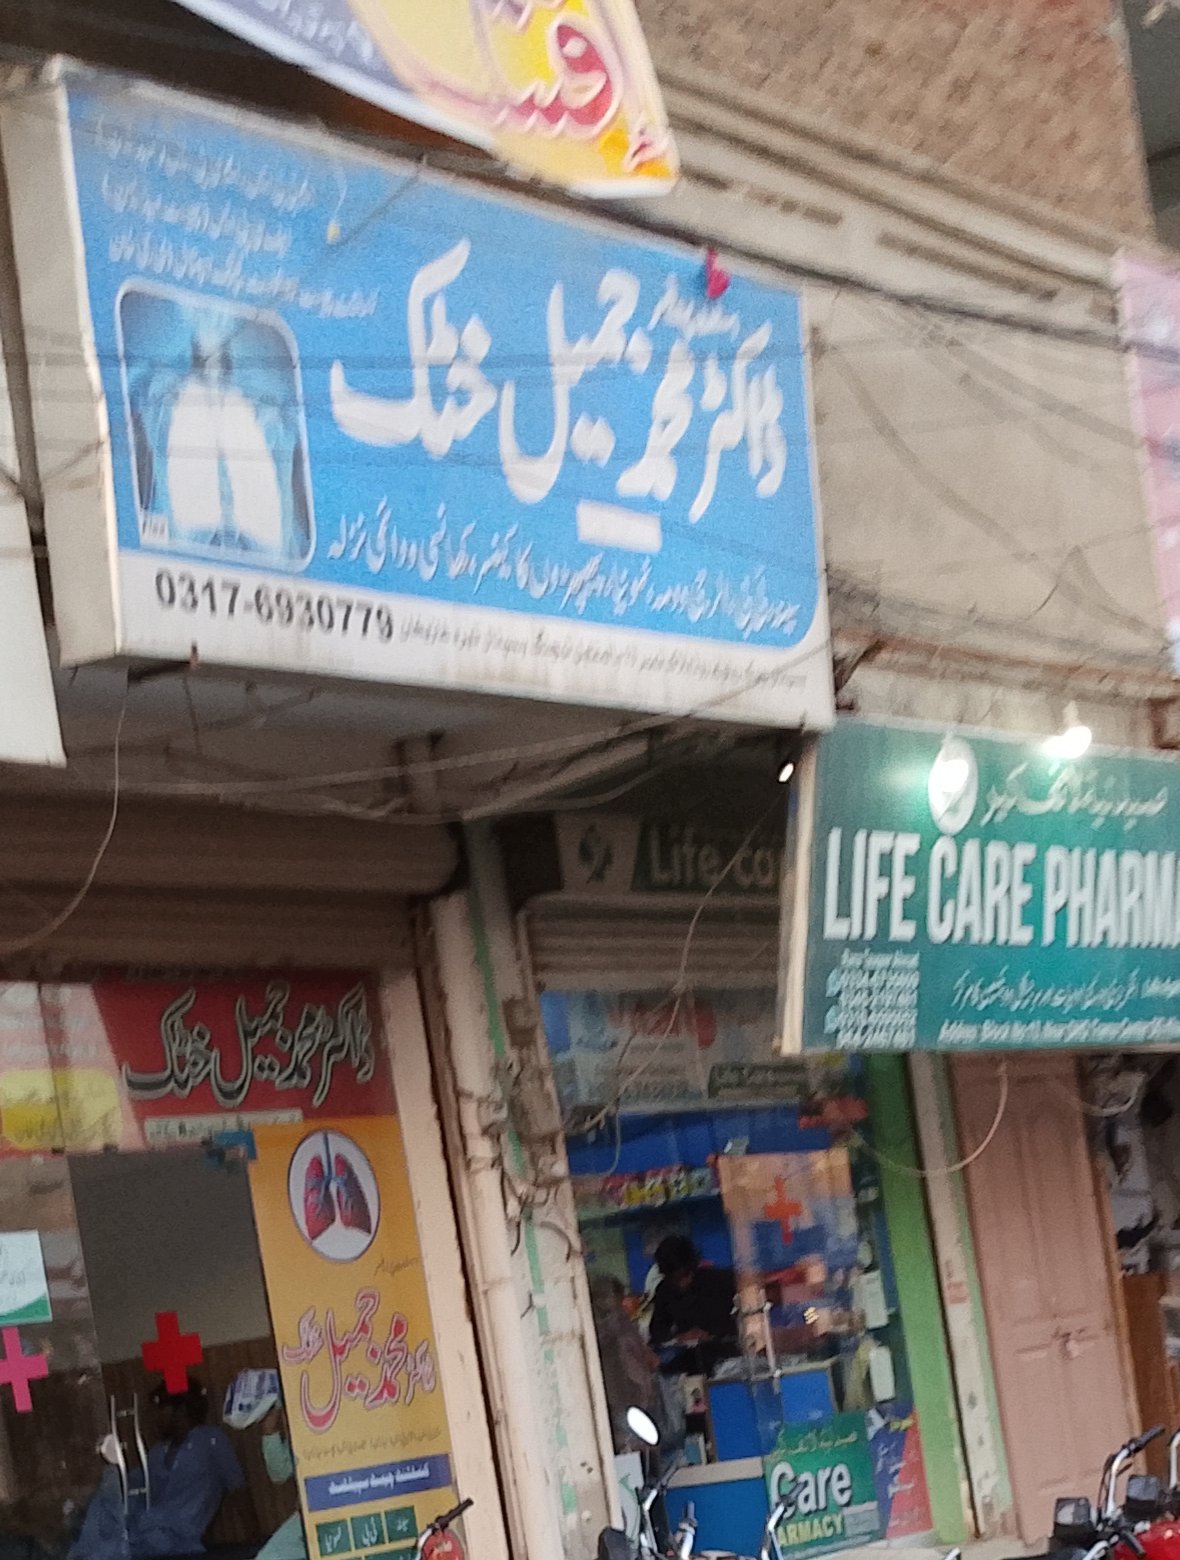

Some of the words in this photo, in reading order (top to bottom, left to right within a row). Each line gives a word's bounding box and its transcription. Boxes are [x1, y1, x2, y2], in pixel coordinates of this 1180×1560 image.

[499, 267, 654, 505] جمیل
[615, 336, 697, 502] محمد
[689, 319, 788, 524] ڈاکٹر
[154, 566, 394, 644] 0317-6930779
[822, 827, 920, 941] LIFE
[927, 835, 1038, 947] CARE
[1042, 844, 1180, 949] PHARM
[210, 979, 294, 1108] جمیل
[275, 1003, 322, 1090] محمد
[312, 981, 376, 1109] ڈاکٹر
[301, 1285, 382, 1435] جمیل
[364, 1311, 409, 1412] محمد
[770, 1461, 853, 1520] Care
[777, 1512, 846, 1547] ARMACY
